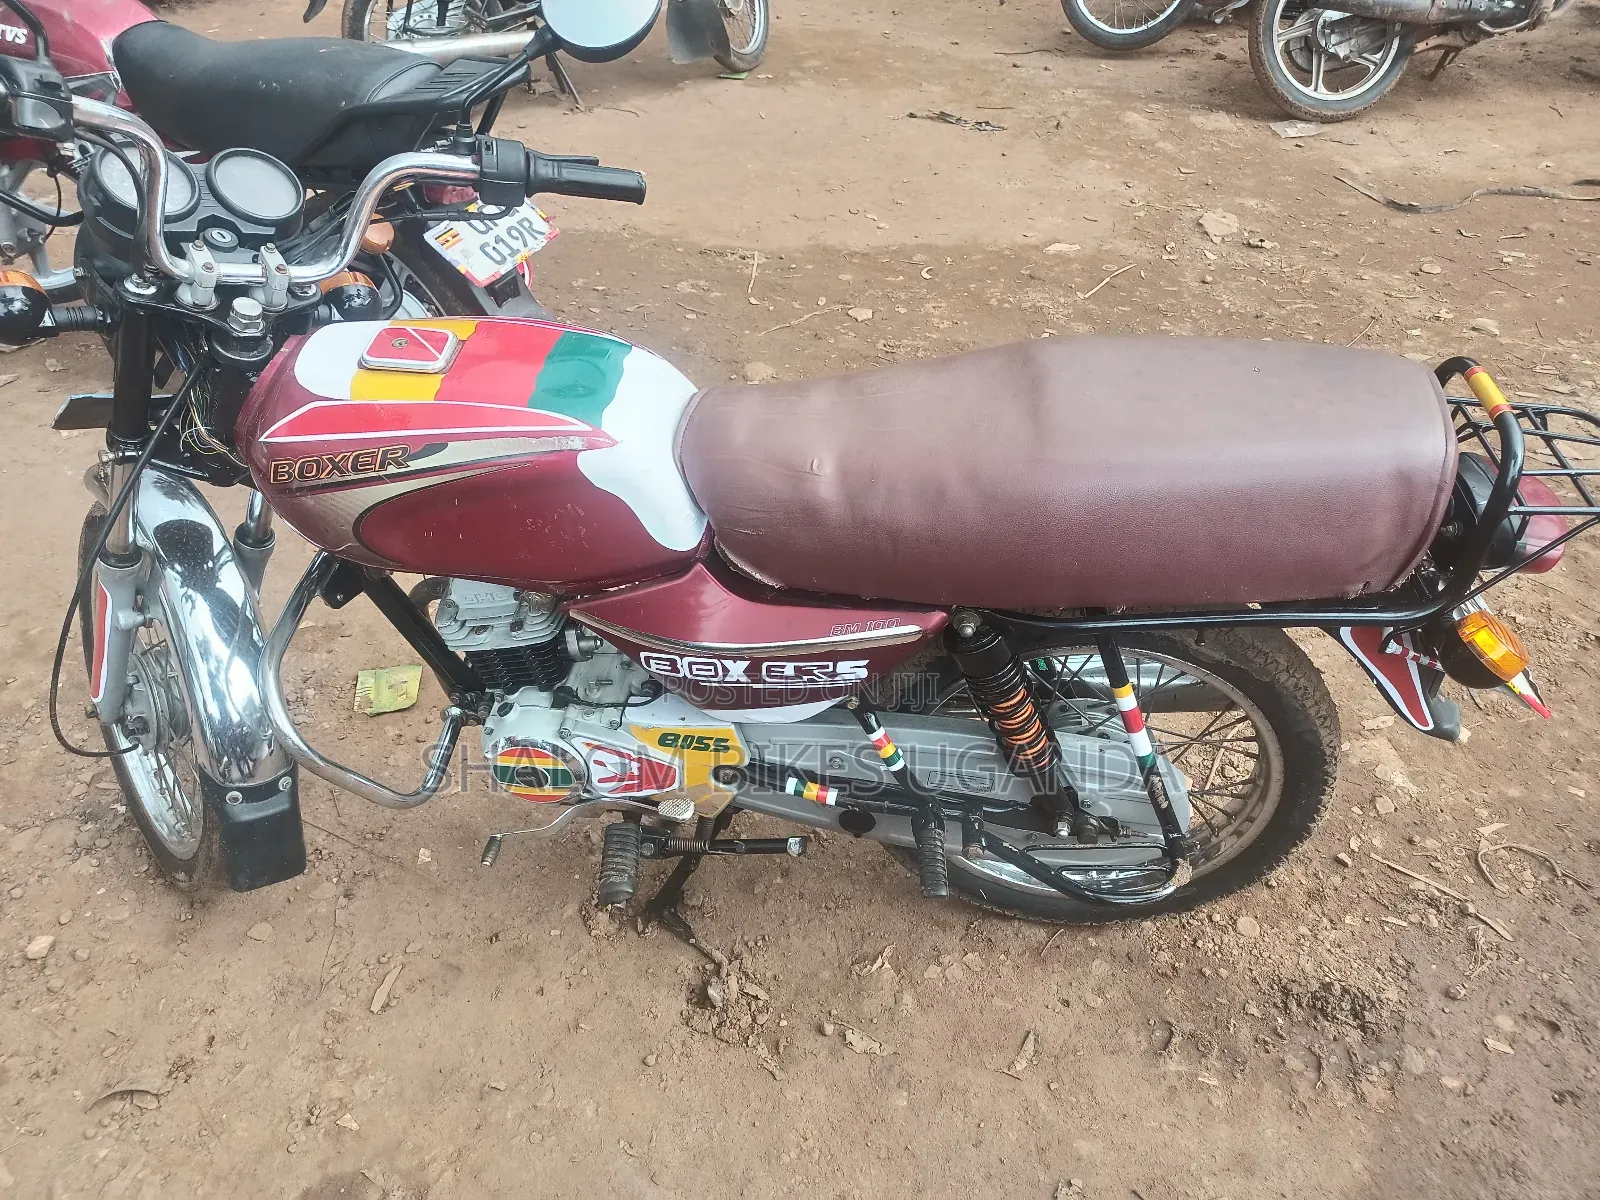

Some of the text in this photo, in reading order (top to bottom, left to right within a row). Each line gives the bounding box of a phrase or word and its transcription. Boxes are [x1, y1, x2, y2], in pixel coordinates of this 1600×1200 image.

[270, 444, 411, 484] BOXER
[830, 623, 861, 637] BM
[658, 732, 731, 753] BOSS
